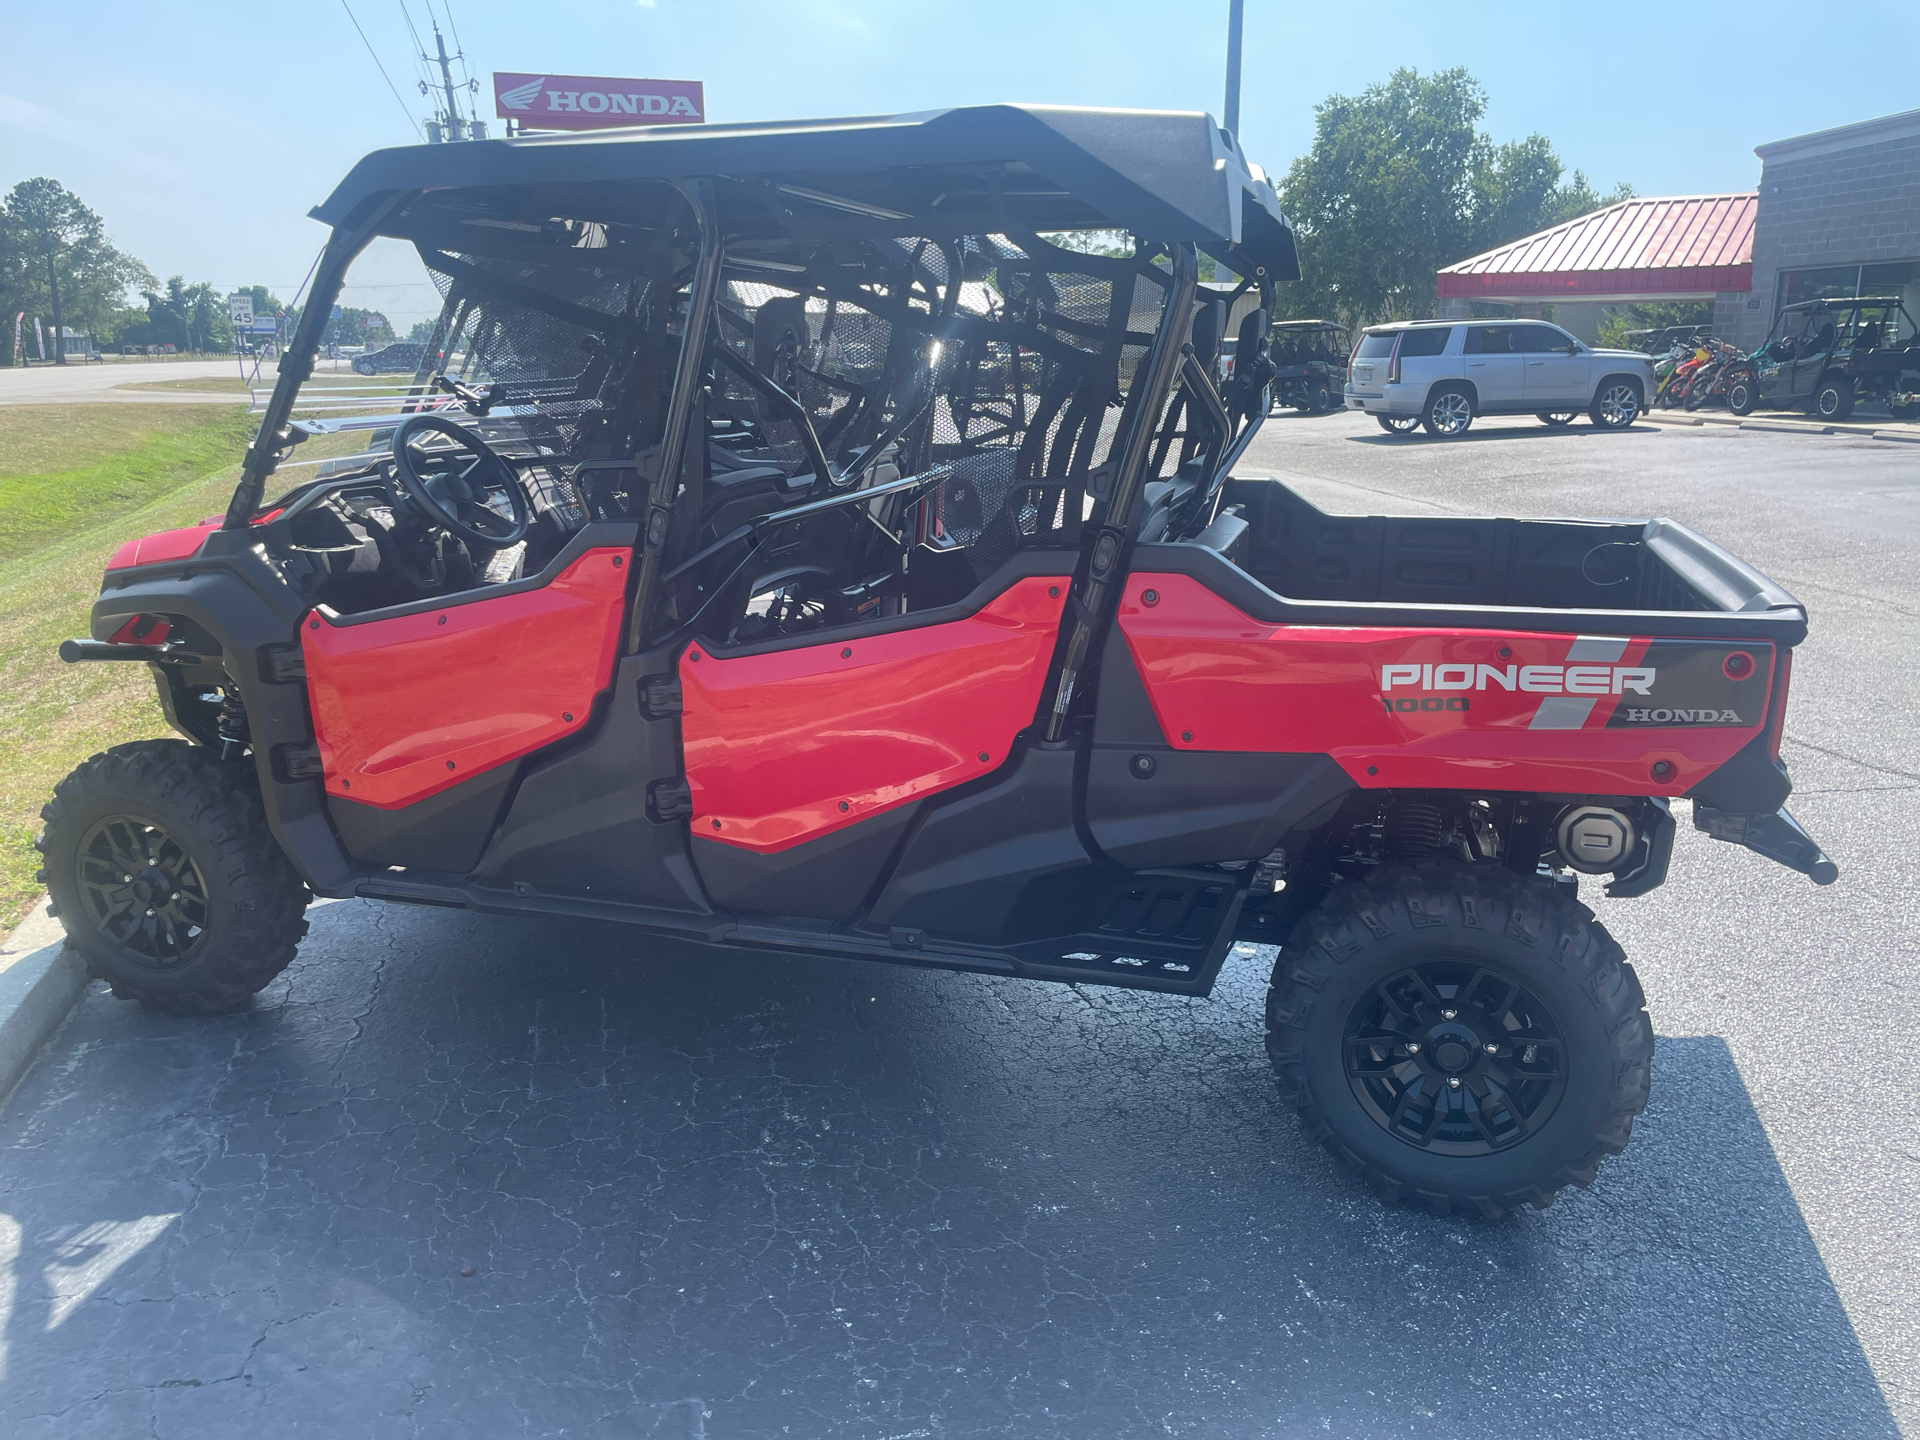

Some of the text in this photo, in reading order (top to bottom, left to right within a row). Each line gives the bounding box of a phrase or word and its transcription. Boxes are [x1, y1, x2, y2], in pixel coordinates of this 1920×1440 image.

[546, 90, 701, 117] HONDA
[234, 313, 252, 323] 45
[1381, 663, 1656, 696] PIONEER
[1381, 697, 1470, 713] 1000
[1626, 708, 1743, 723] HONDA
